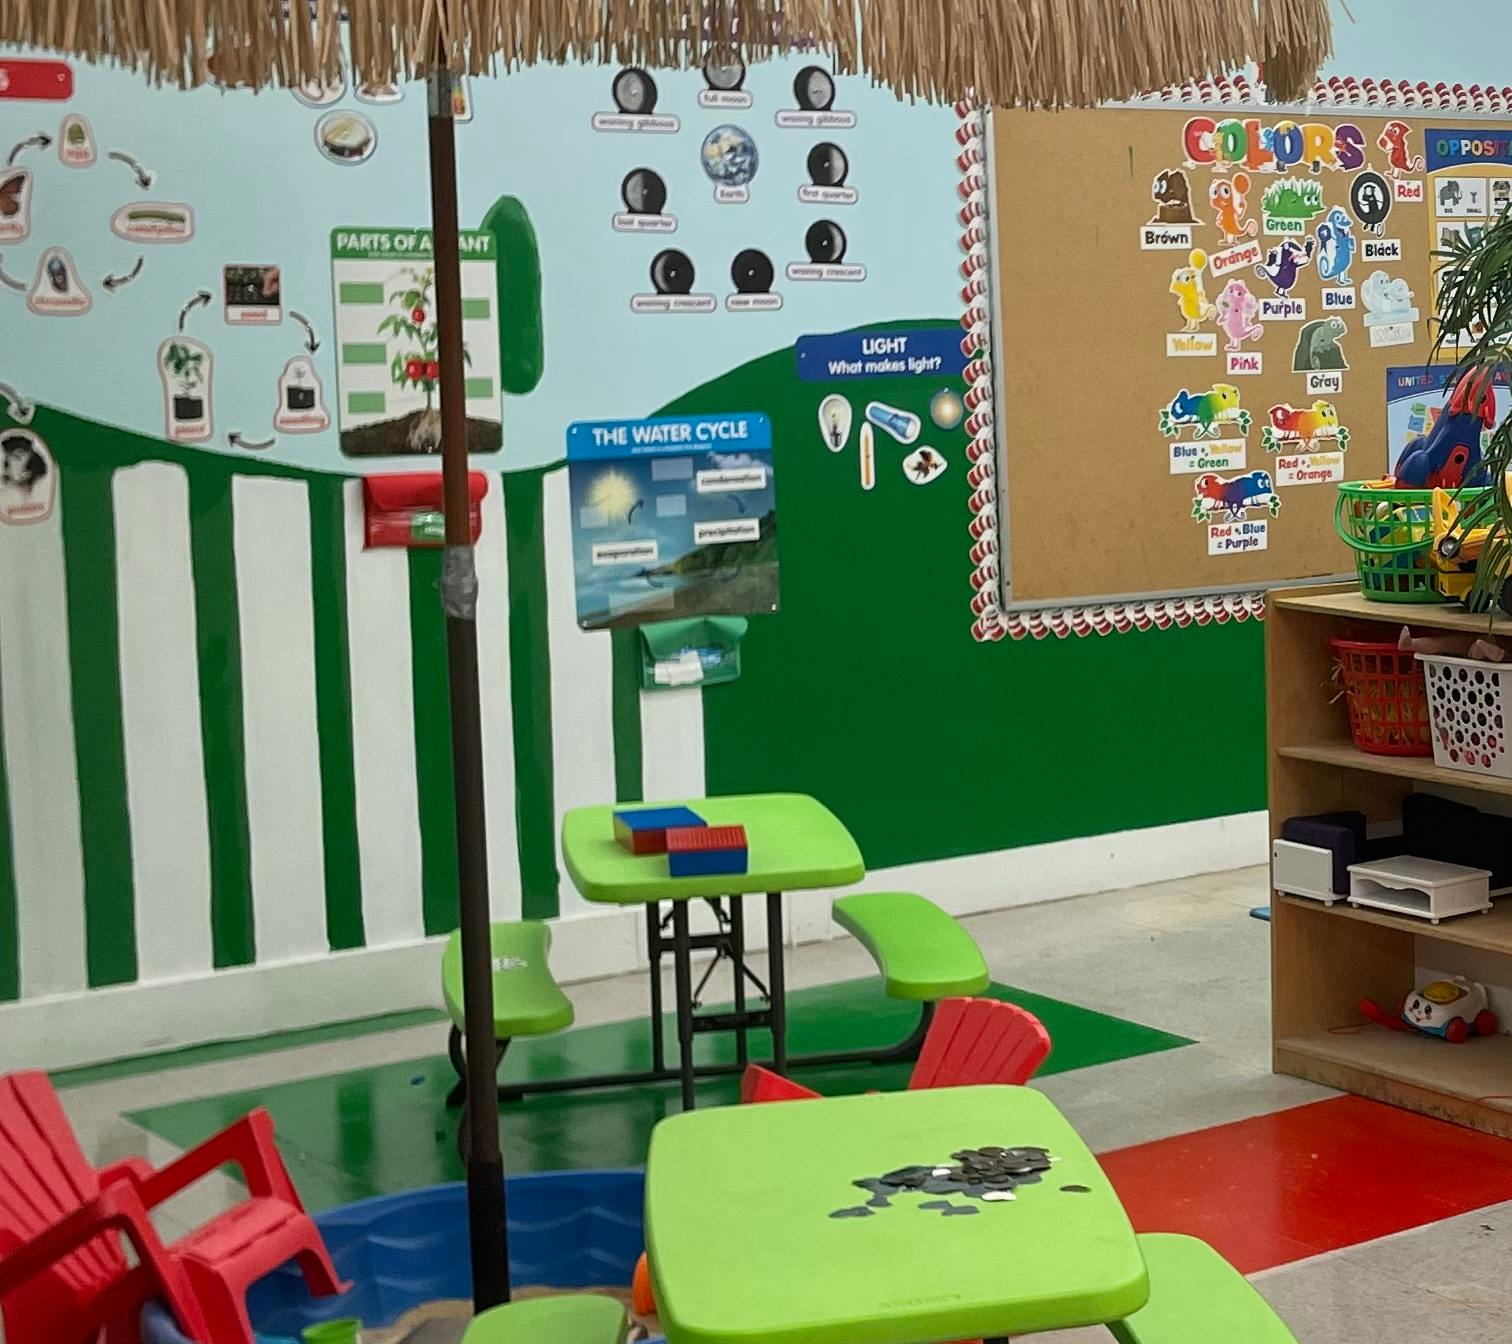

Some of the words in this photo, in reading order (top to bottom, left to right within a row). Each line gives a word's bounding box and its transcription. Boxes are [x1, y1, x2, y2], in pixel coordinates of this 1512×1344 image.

[1184, 117, 1366, 172] COLORS
[1397, 183, 1421, 198] Red
[1266, 218, 1302, 232] Green
[336, 233, 390, 251] PARTS
[394, 234, 417, 251] OF
[1145, 230, 1188, 245] Brown
[1365, 243, 1399, 257] Black
[1213, 246, 1259, 270] Orange
[1325, 292, 1352, 306] Blue
[1263, 301, 1303, 316] Purple
[862, 337, 907, 355] LIGHT
[1172, 337, 1214, 353] Yellow
[828, 359, 862, 375] What
[865, 358, 905, 373] makes
[908, 356, 942, 375] light?
[1230, 357, 1259, 371] Pink
[1310, 375, 1340, 392] Gray
[592, 427, 628, 446] THE
[631, 423, 691, 444] WATER
[695, 420, 748, 441] CYCLE
[1173, 445, 1198, 457] Blue
[1210, 444, 1242, 455] Yellow
[1198, 458, 1229, 469] Green
[1279, 458, 1299, 469] Red
[1311, 455, 1340, 466] Yellow
[1296, 469, 1333, 482] Orange
[1211, 526, 1232, 538] Red
[1242, 523, 1266, 535] Blue
[1225, 537, 1259, 551] Purple
